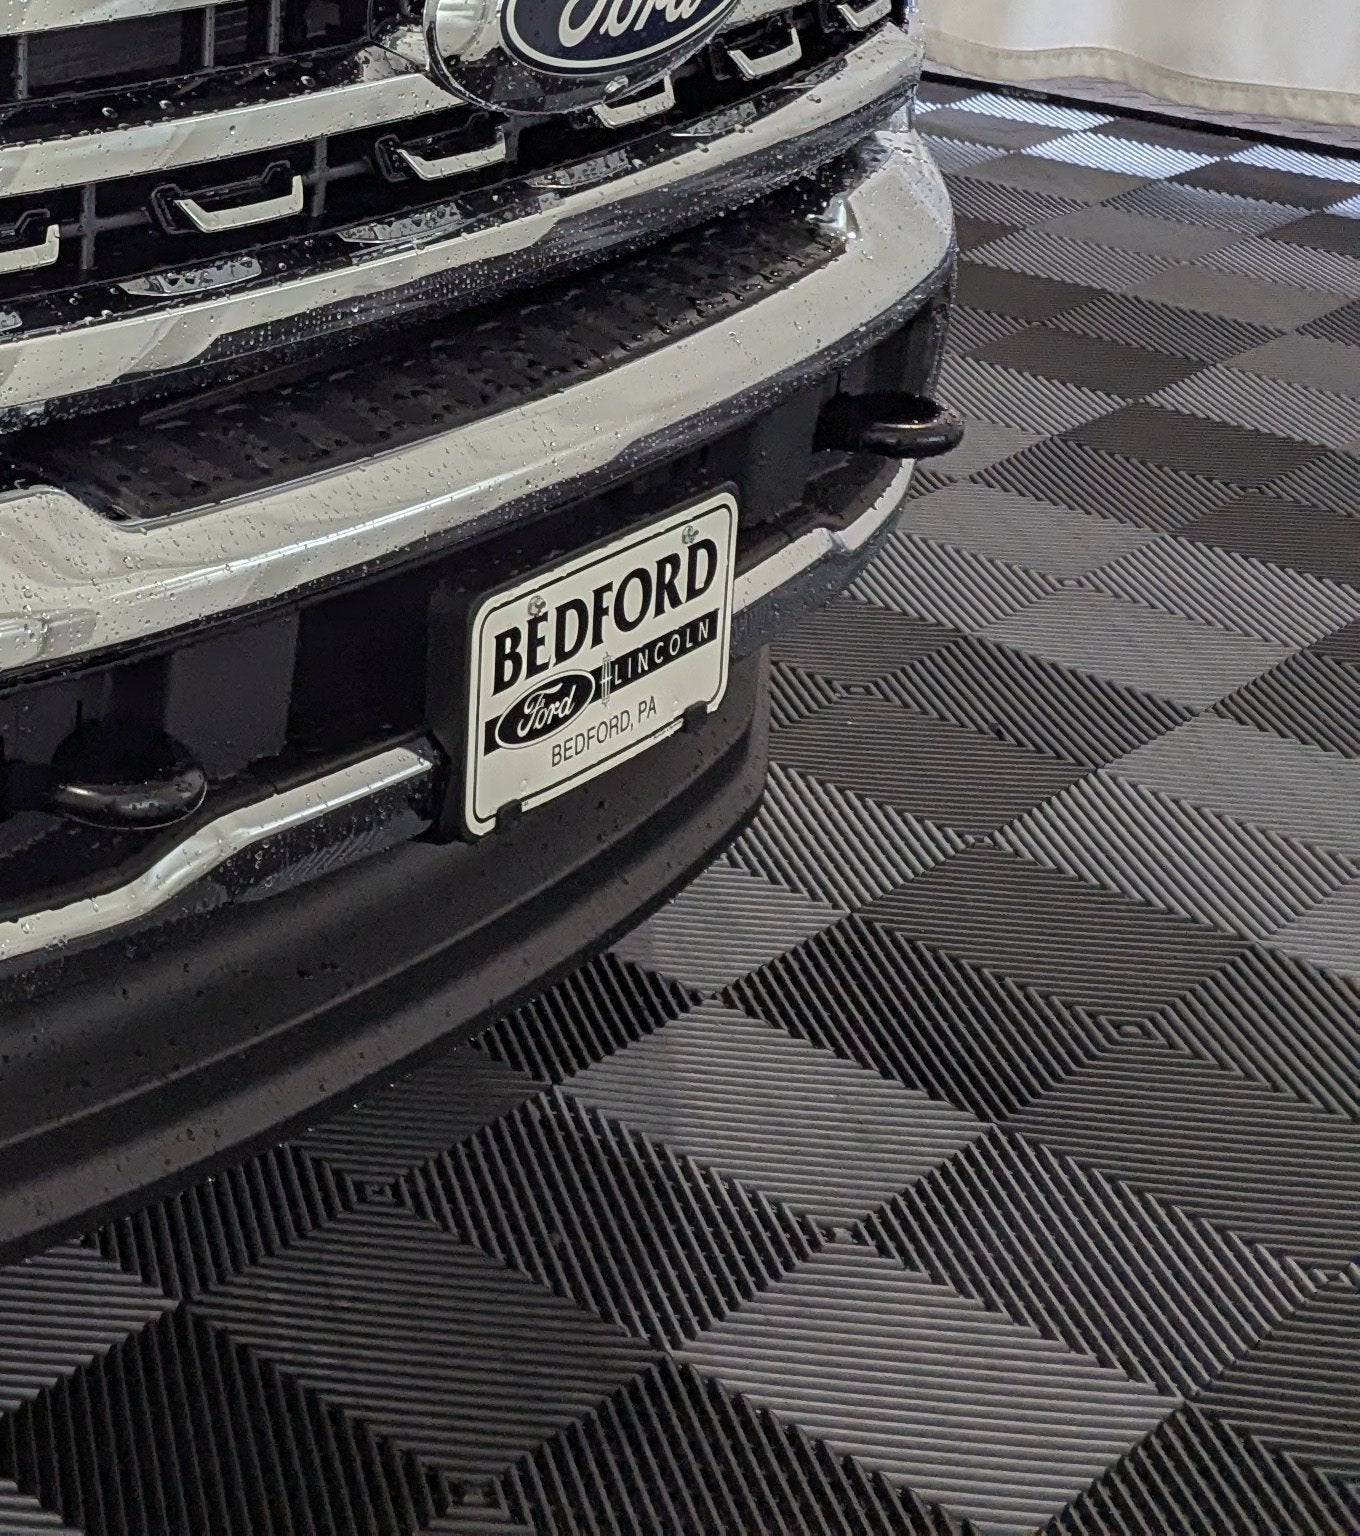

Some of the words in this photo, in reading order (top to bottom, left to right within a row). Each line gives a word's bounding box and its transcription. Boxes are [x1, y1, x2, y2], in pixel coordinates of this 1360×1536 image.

[493, 539, 718, 696] BEDFORD
[516, 683, 576, 738] Ford
[613, 618, 711, 686] LINCOLN
[551, 714, 634, 768] BEDFORD,
[635, 696, 658, 726] PA
